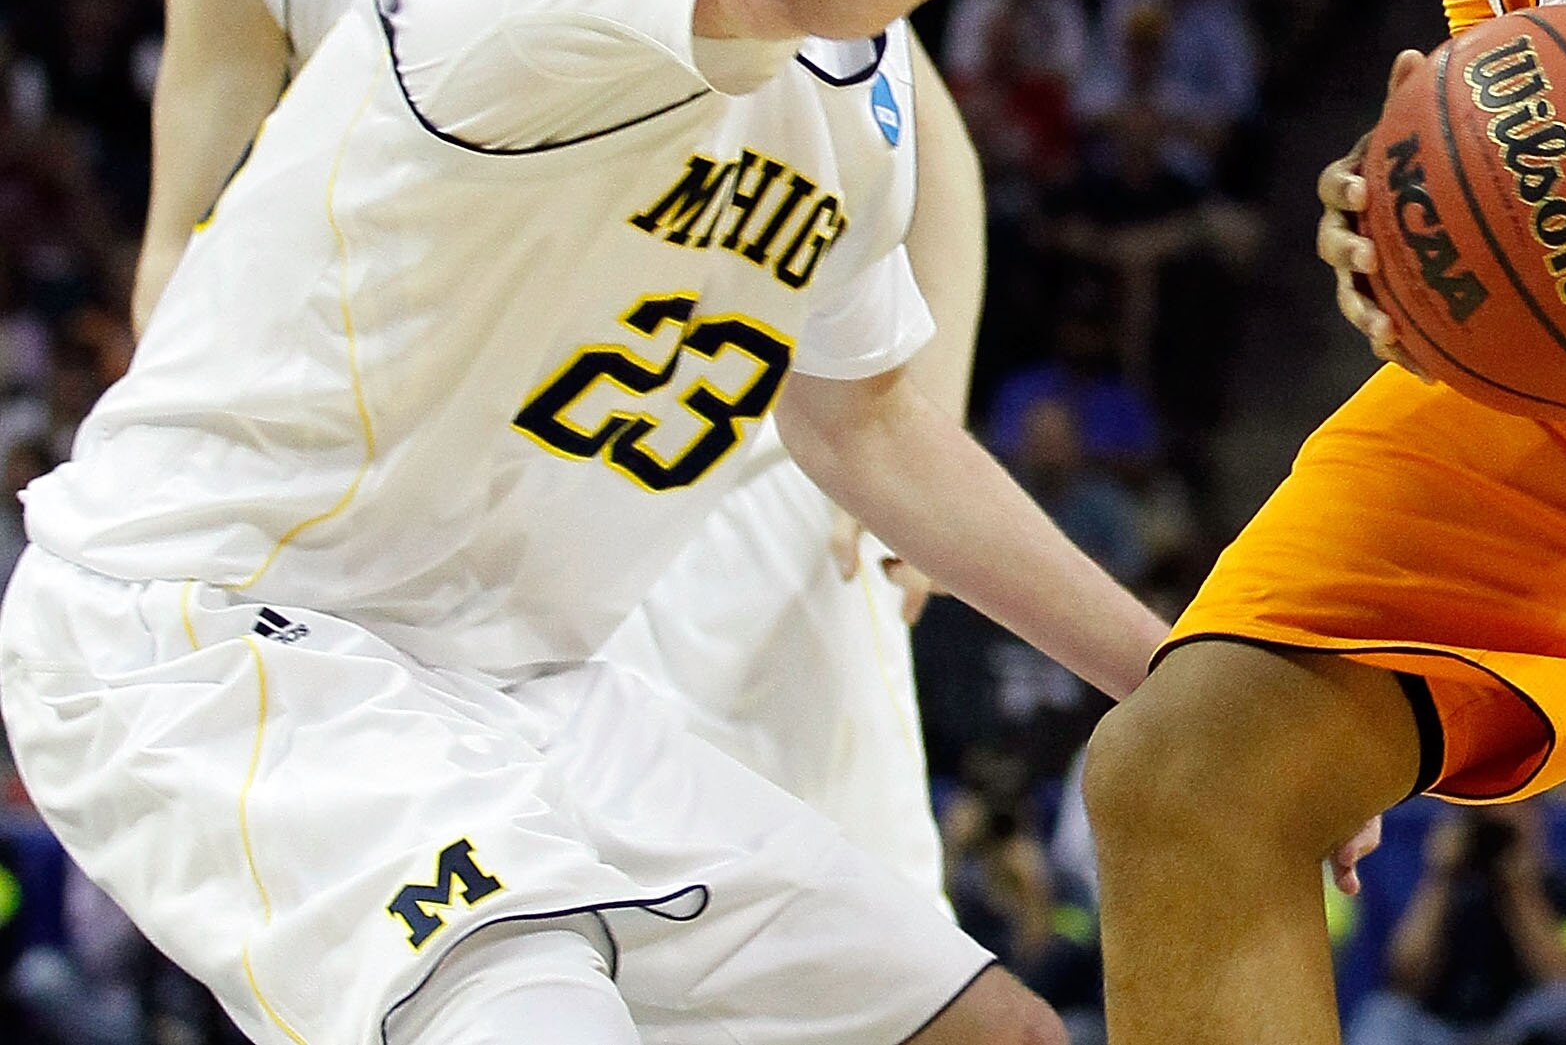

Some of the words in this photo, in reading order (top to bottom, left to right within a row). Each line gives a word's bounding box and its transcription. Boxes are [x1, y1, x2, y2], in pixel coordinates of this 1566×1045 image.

[1385, 131, 1489, 323] NCAA
[510, 290, 797, 495] 23
[384, 834, 507, 953] M
